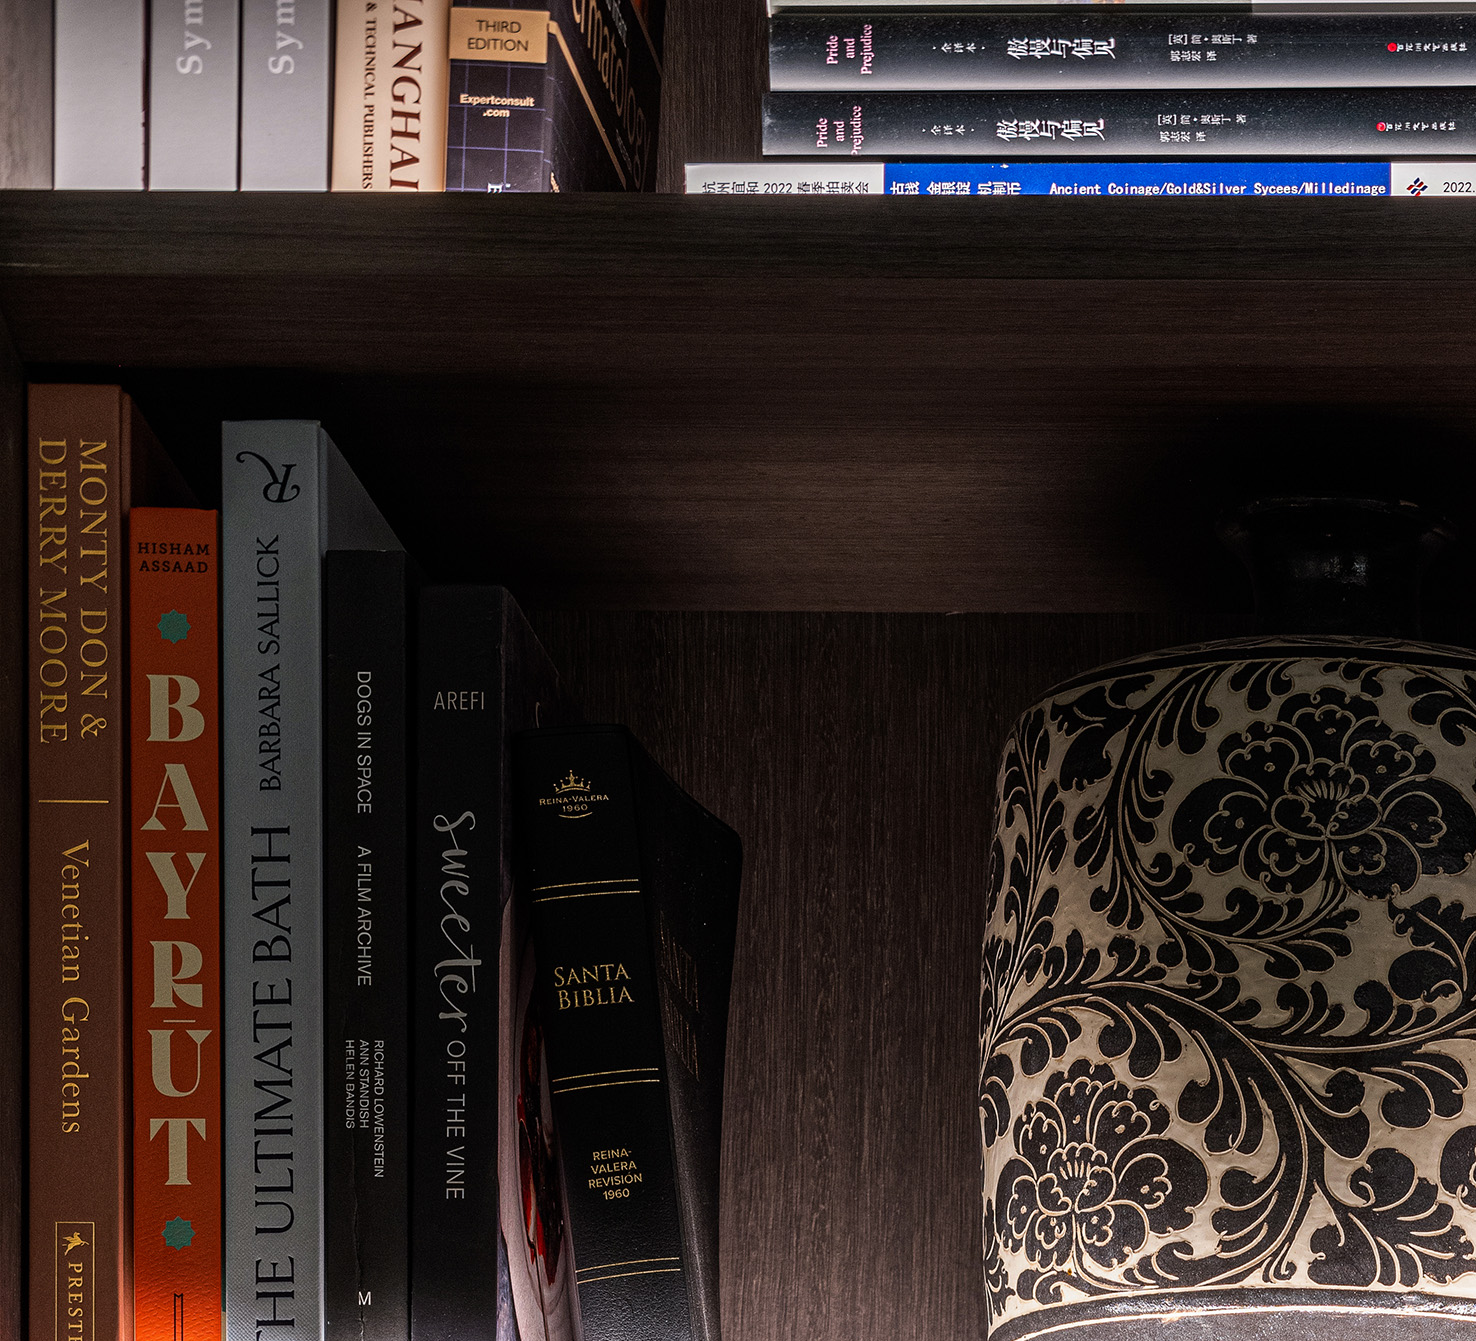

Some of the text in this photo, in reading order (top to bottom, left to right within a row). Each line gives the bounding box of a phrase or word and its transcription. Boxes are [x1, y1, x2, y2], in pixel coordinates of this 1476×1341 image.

[468, 38, 528, 51] EDITION
[476, 20, 521, 33] THIRD
[826, 35, 838, 64] Pride
[861, 24, 872, 74] Prejudice
[1006, 38, 1116, 59] 傲慢与偏见
[816, 118, 828, 148] Pride
[851, 105, 862, 156] Prejudice
[996, 119, 1105, 141] 傲慢与偏见
[1050, 184, 1101, 195] Ancient
[138, 543, 210, 556] HISHAM
[140, 560, 208, 573] ASSAAD
[38, 438, 68, 744] DERRY MOORE
[80, 440, 108, 738] MONTY DON &
[256, 534, 282, 791] BARBARA SALLICK
[434, 692, 485, 710] AREFI
[357, 671, 371, 986] DOGS IN SPACE A FILM ARCHIVE
[251, 826, 291, 963] BATH
[61, 840, 90, 1133] Venetian Gardens
[554, 964, 631, 988] SANTA
[433, 811, 482, 1200] Sweeter OFF THE VINE
[558, 987, 635, 1010] BIBLIA
[359, 1040, 369, 1128] ANN STANDISH
[253, 978, 295, 1237] ULTIMATE
[374, 1040, 384, 1178] RICHARD LOWENSTEIN
